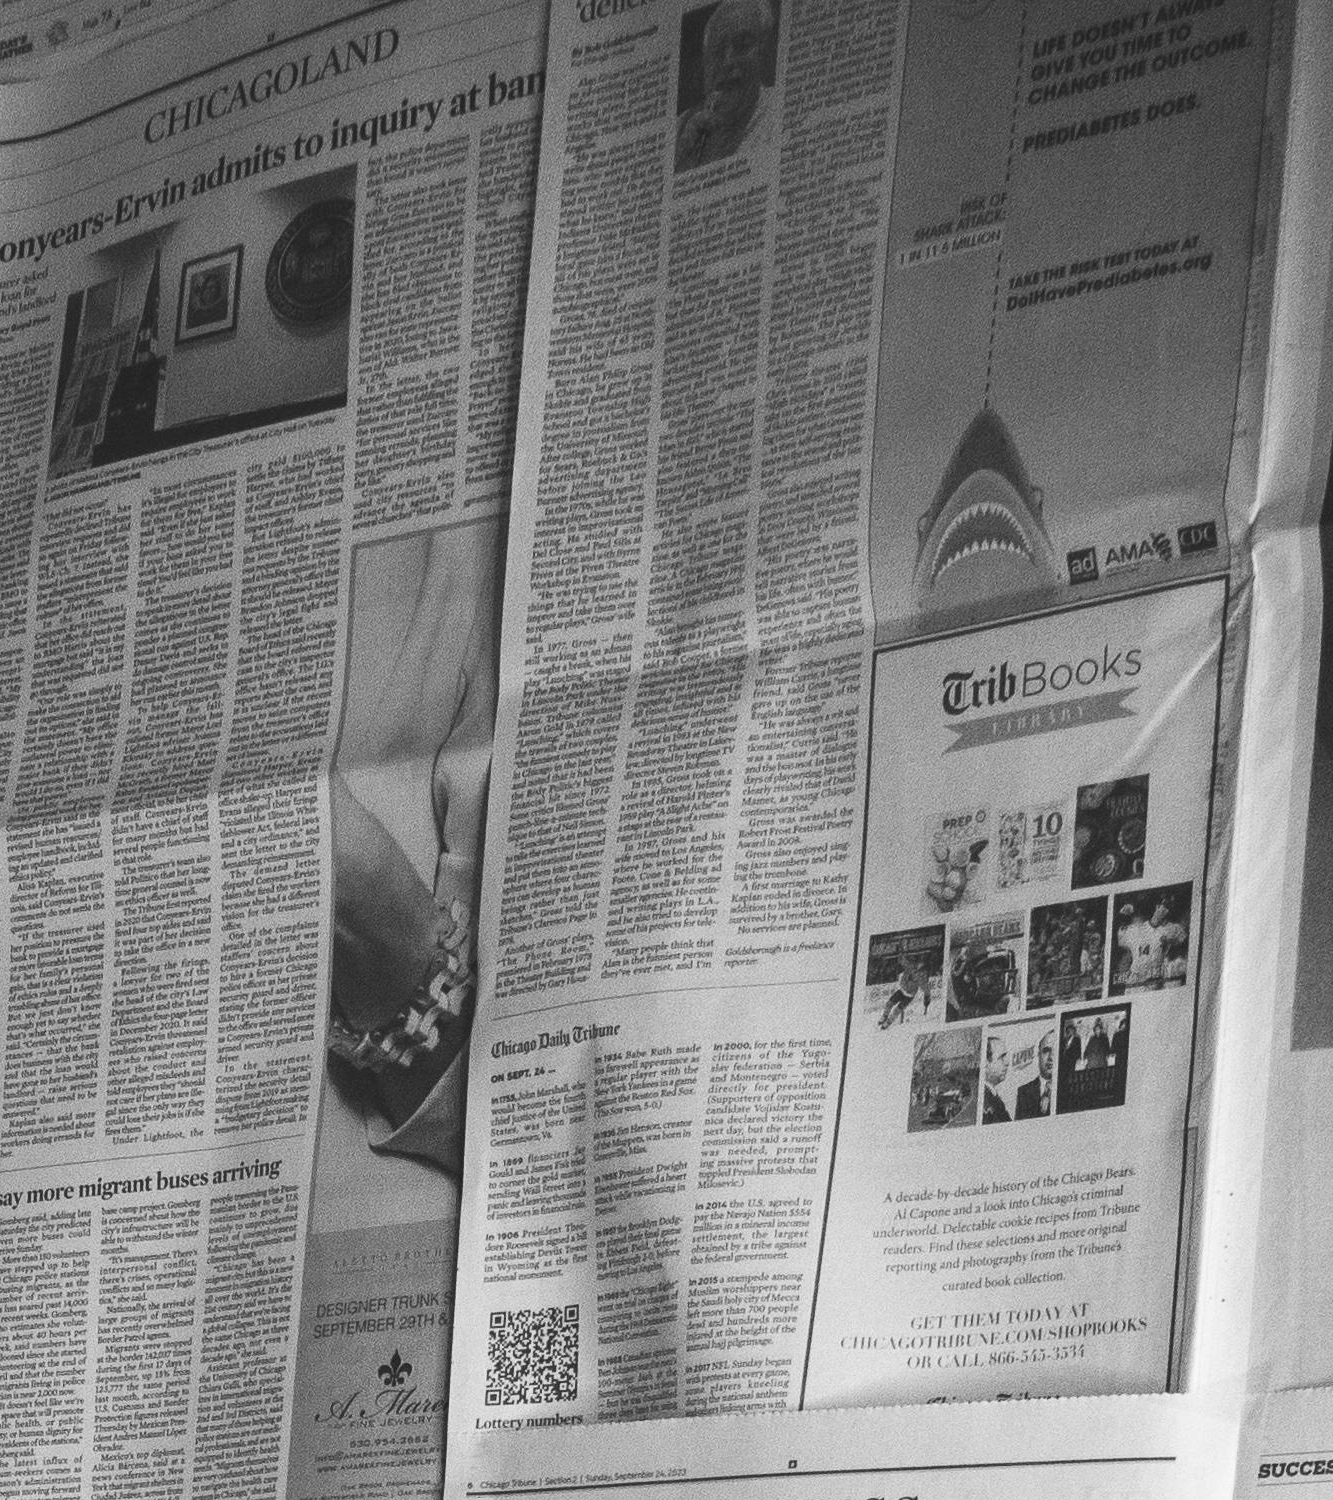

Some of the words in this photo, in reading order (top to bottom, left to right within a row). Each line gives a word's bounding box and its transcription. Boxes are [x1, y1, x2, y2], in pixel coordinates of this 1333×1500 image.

[144, 27, 400, 144] CHICAGOLAND
[27, 1186, 74, 1203] more
[79, 1176, 152, 1200] migrant
[157, 1171, 209, 1190] buses
[212, 1159, 283, 1184] arriving
